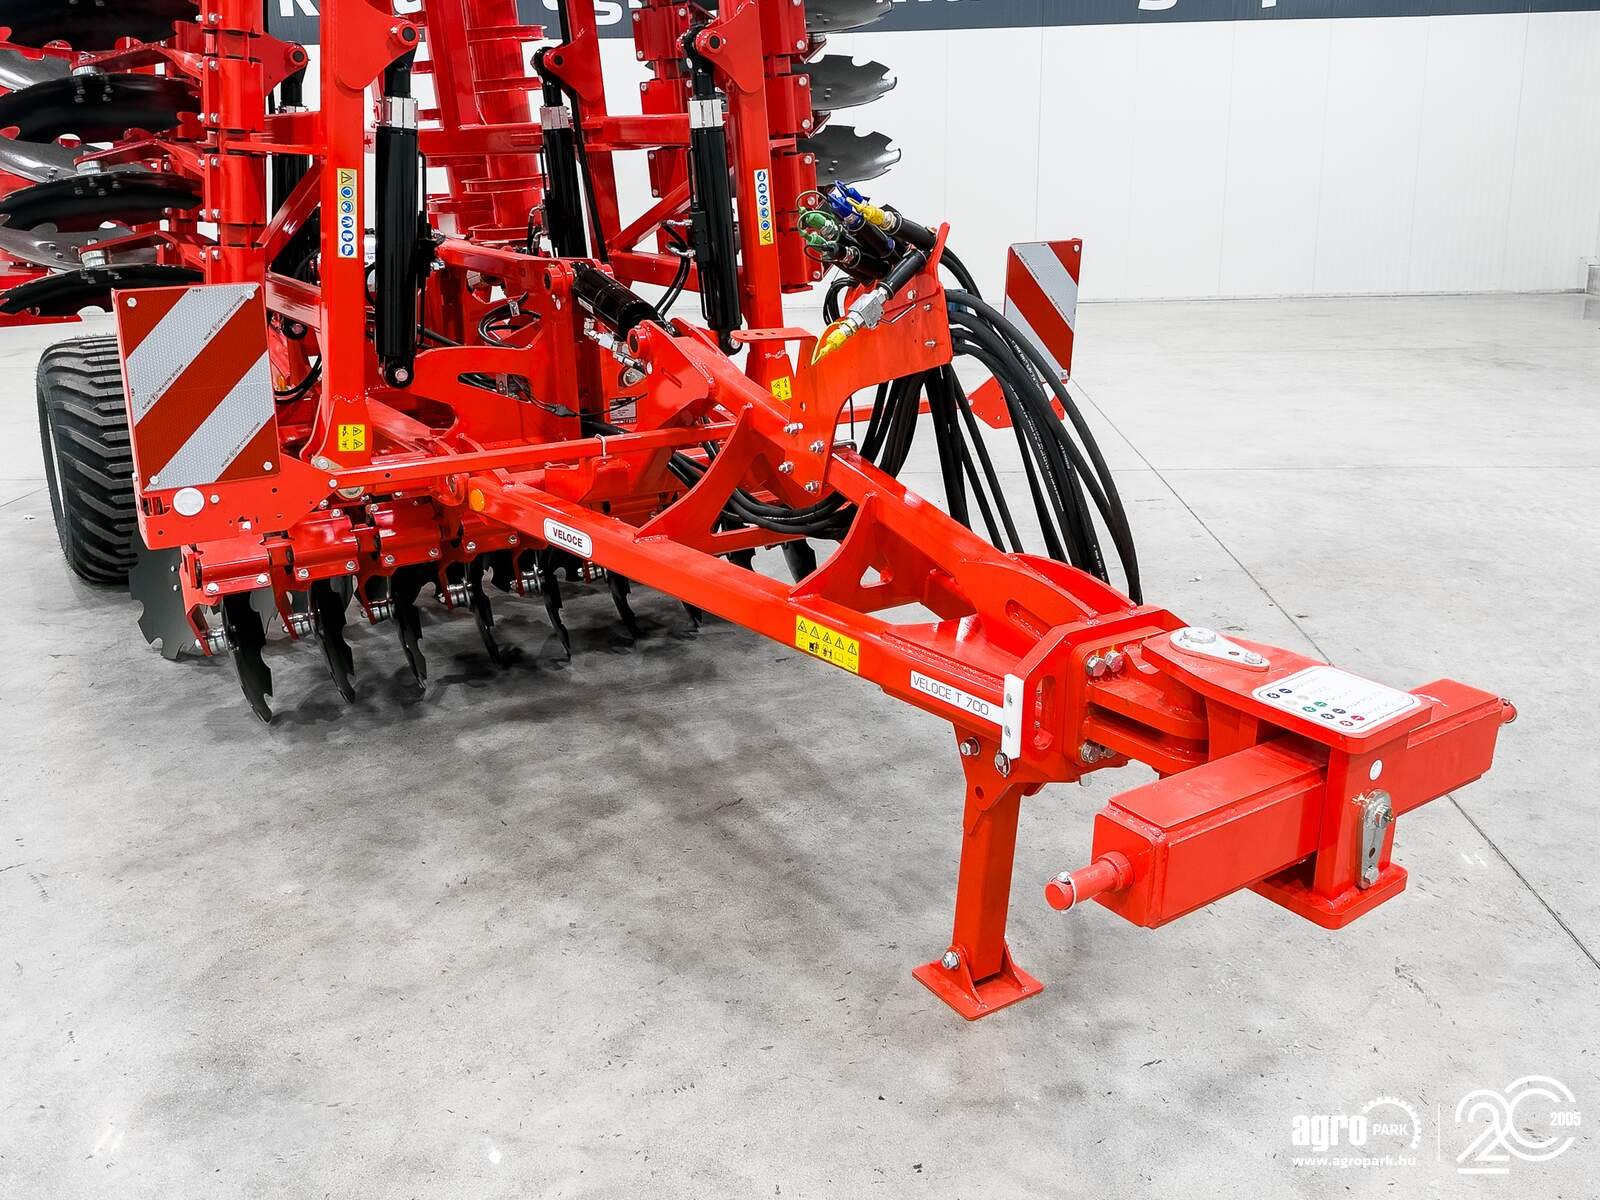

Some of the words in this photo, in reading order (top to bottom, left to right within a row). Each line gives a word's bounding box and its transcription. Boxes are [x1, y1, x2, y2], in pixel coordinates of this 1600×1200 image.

[552, 526, 583, 548] VELOCE
[912, 674, 952, 700] VELOCE
[955, 692, 962, 703] T
[966, 697, 989, 716] 700
